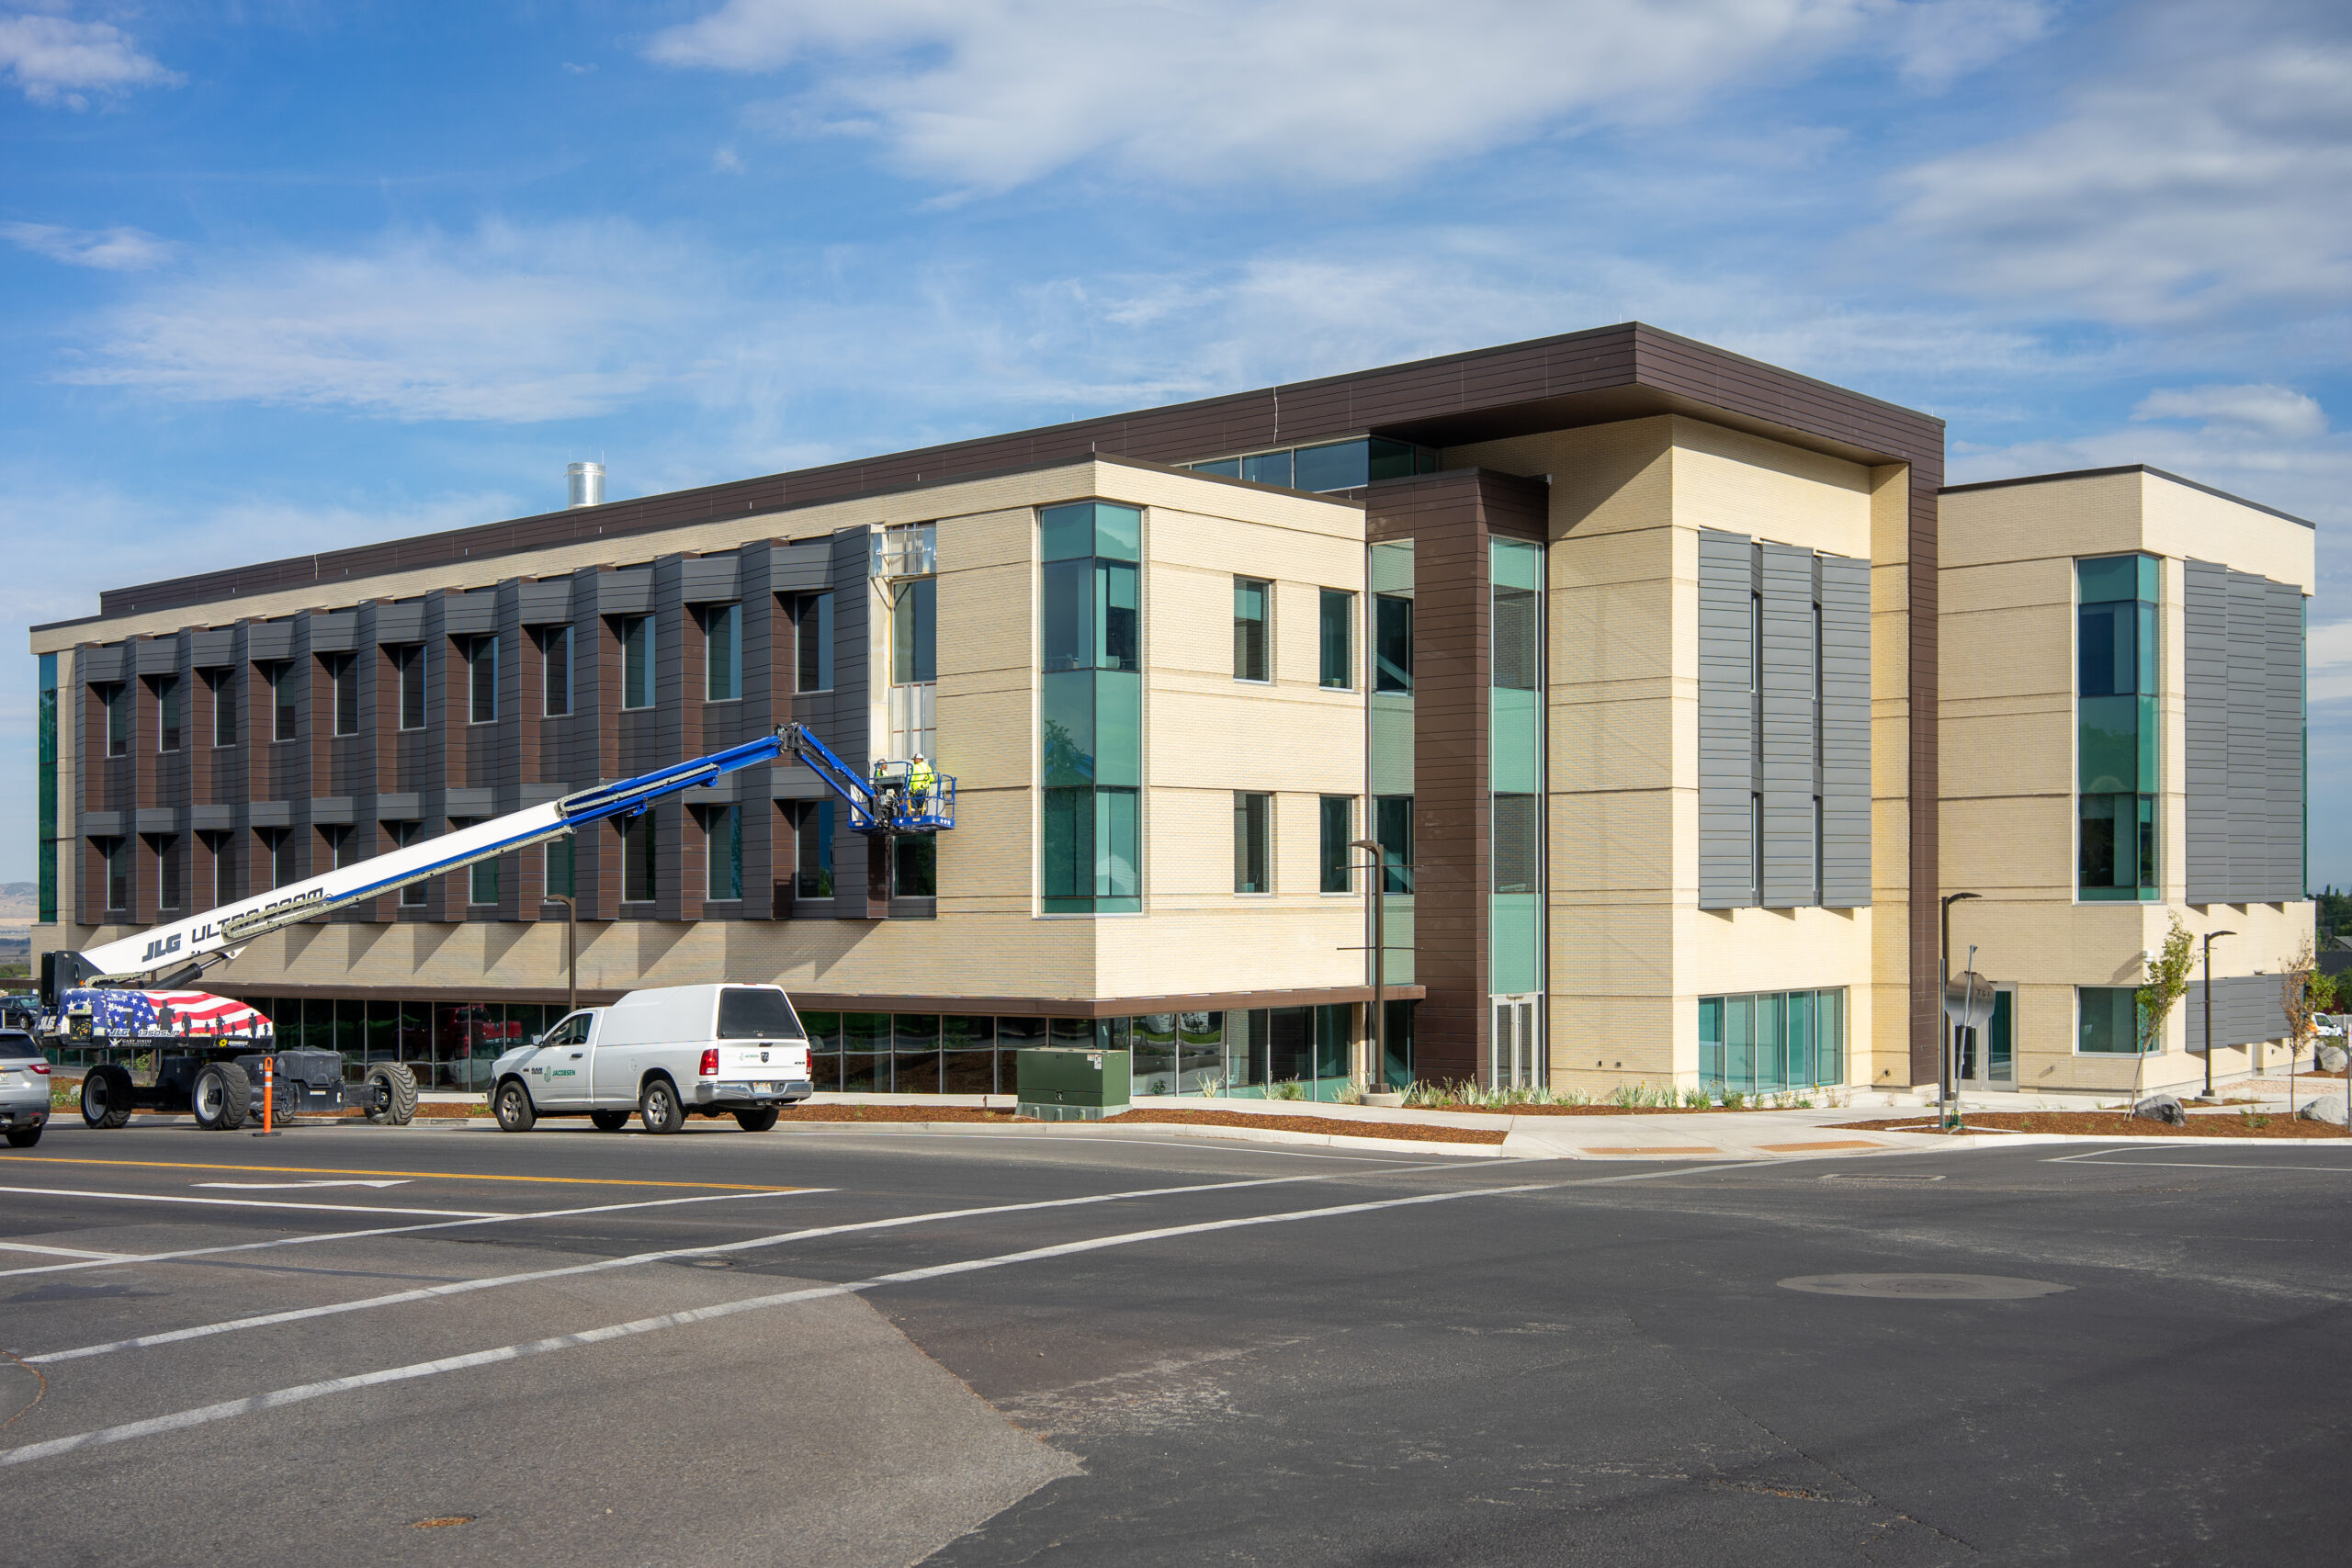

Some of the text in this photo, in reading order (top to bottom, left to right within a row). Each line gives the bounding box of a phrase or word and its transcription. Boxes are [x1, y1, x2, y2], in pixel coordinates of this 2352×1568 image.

[141, 932, 182, 963] JLG
[37, 1015, 57, 1030] JLG
[108, 1028, 130, 1037] JLG
